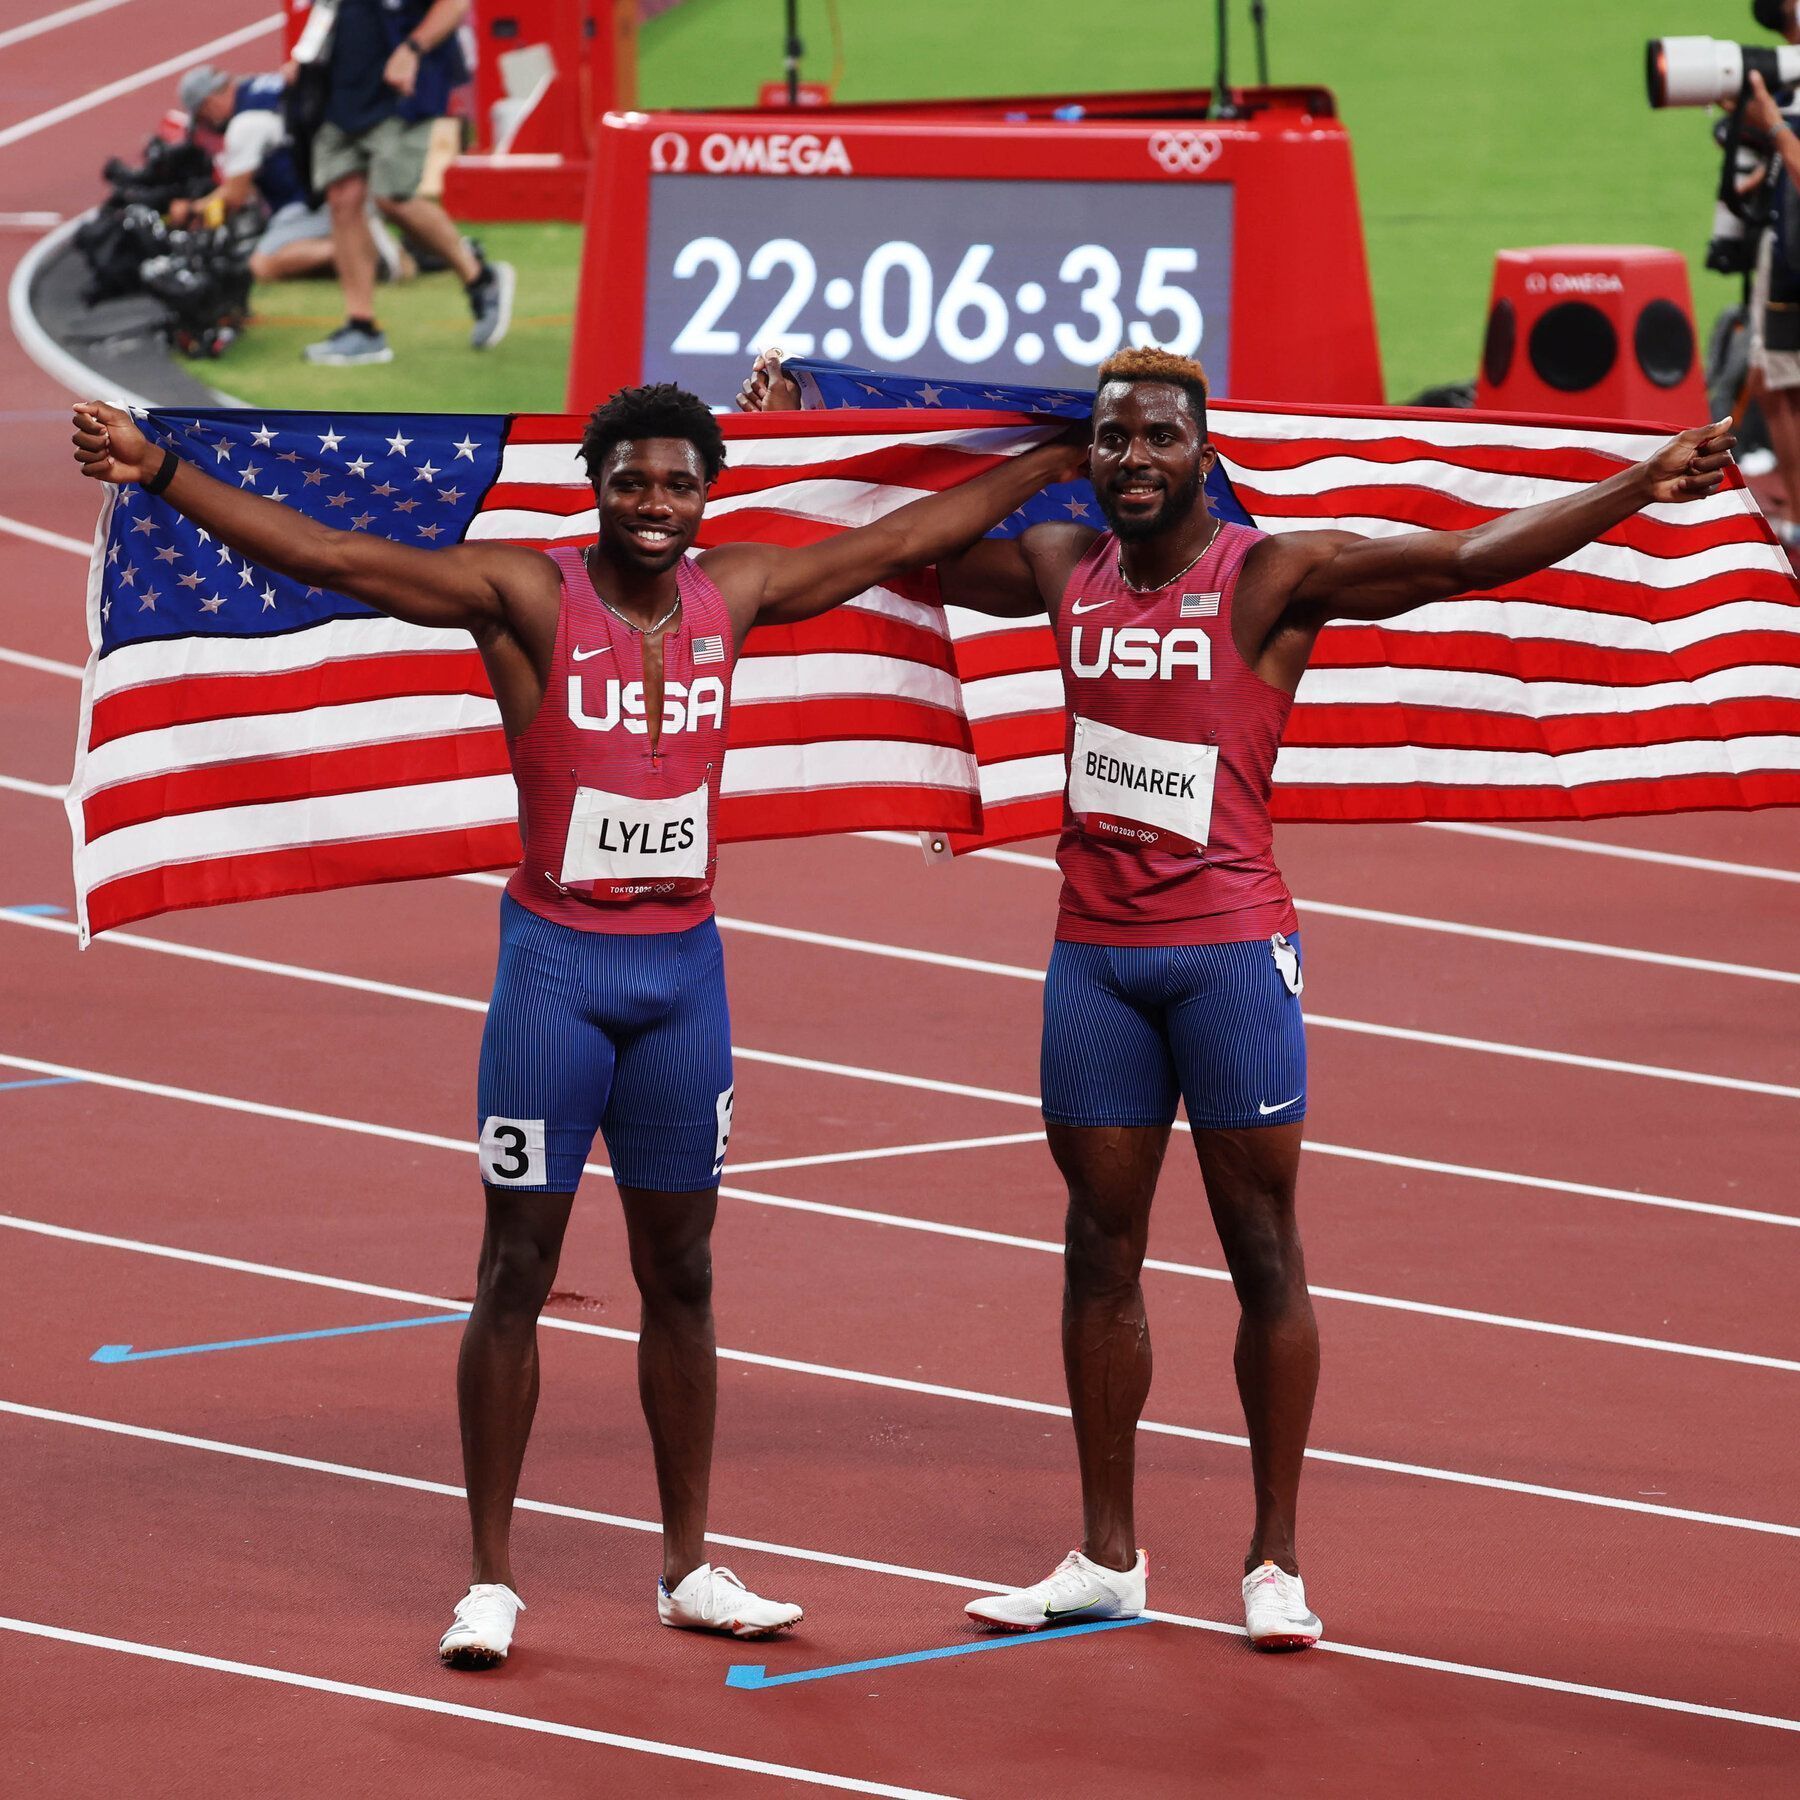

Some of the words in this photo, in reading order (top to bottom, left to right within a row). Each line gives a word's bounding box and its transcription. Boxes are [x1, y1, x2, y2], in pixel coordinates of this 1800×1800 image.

[701, 133, 853, 174] OMEGA
[671, 236, 1203, 365] 22:06:35
[1549, 272, 1624, 294] OMEGA
[1071, 626, 1211, 680] USA
[567, 675, 725, 734] USA
[1086, 751, 1196, 799] BEDNAREK
[598, 817, 694, 854] LYLES
[1098, 821, 1119, 833] TOKYO
[1119, 827, 1135, 837] 2020
[610, 886, 633, 894] TOKYO
[492, 1125, 529, 1179] 3
